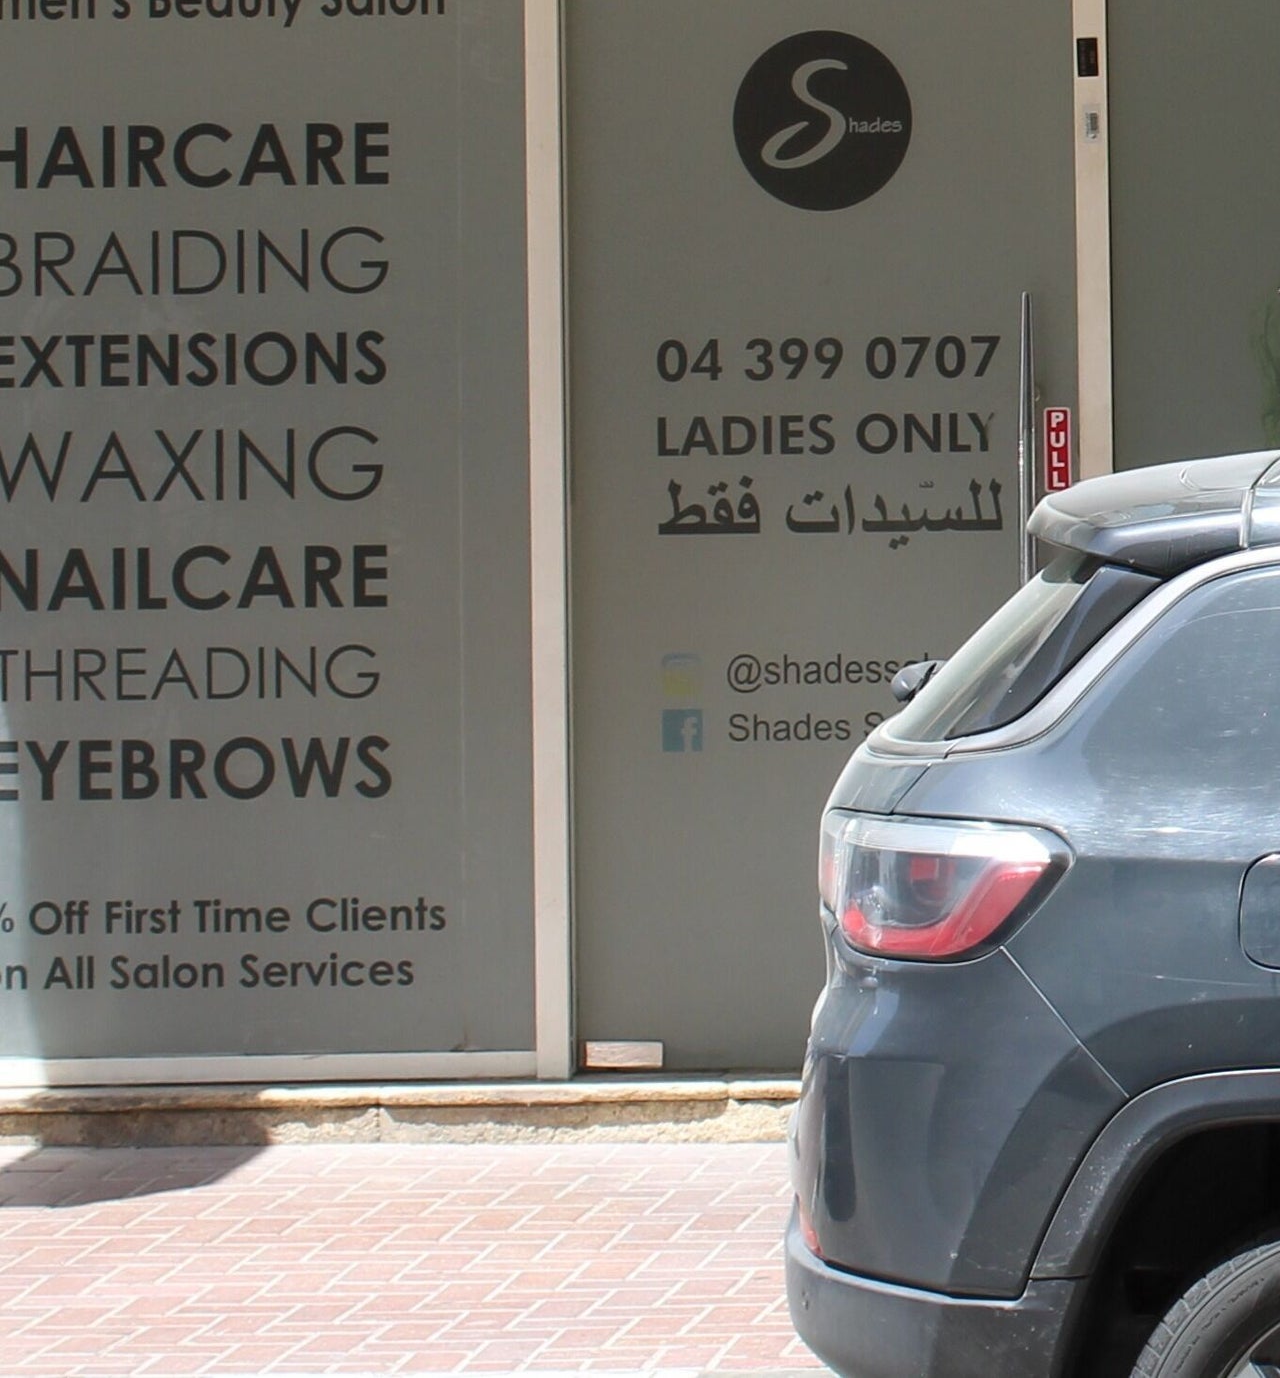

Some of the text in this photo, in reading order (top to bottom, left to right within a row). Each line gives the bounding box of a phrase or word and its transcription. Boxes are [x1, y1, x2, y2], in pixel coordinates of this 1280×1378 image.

[656, 335, 1001, 383] 04 399 0707
[657, 412, 995, 457] LADIES ONLY
[1049, 411, 1066, 488] PULL
[0, 425, 384, 503] WAXING
[658, 475, 761, 536] فقط
[728, 712, 851, 742] Shades
[29, 900, 90, 936] Off
[105, 899, 182, 935] First
[193, 898, 291, 934] Time
[306, 897, 446, 933] Clients
[43, 955, 95, 990] All
[110, 954, 224, 990] Salon
[239, 952, 414, 989] Services
